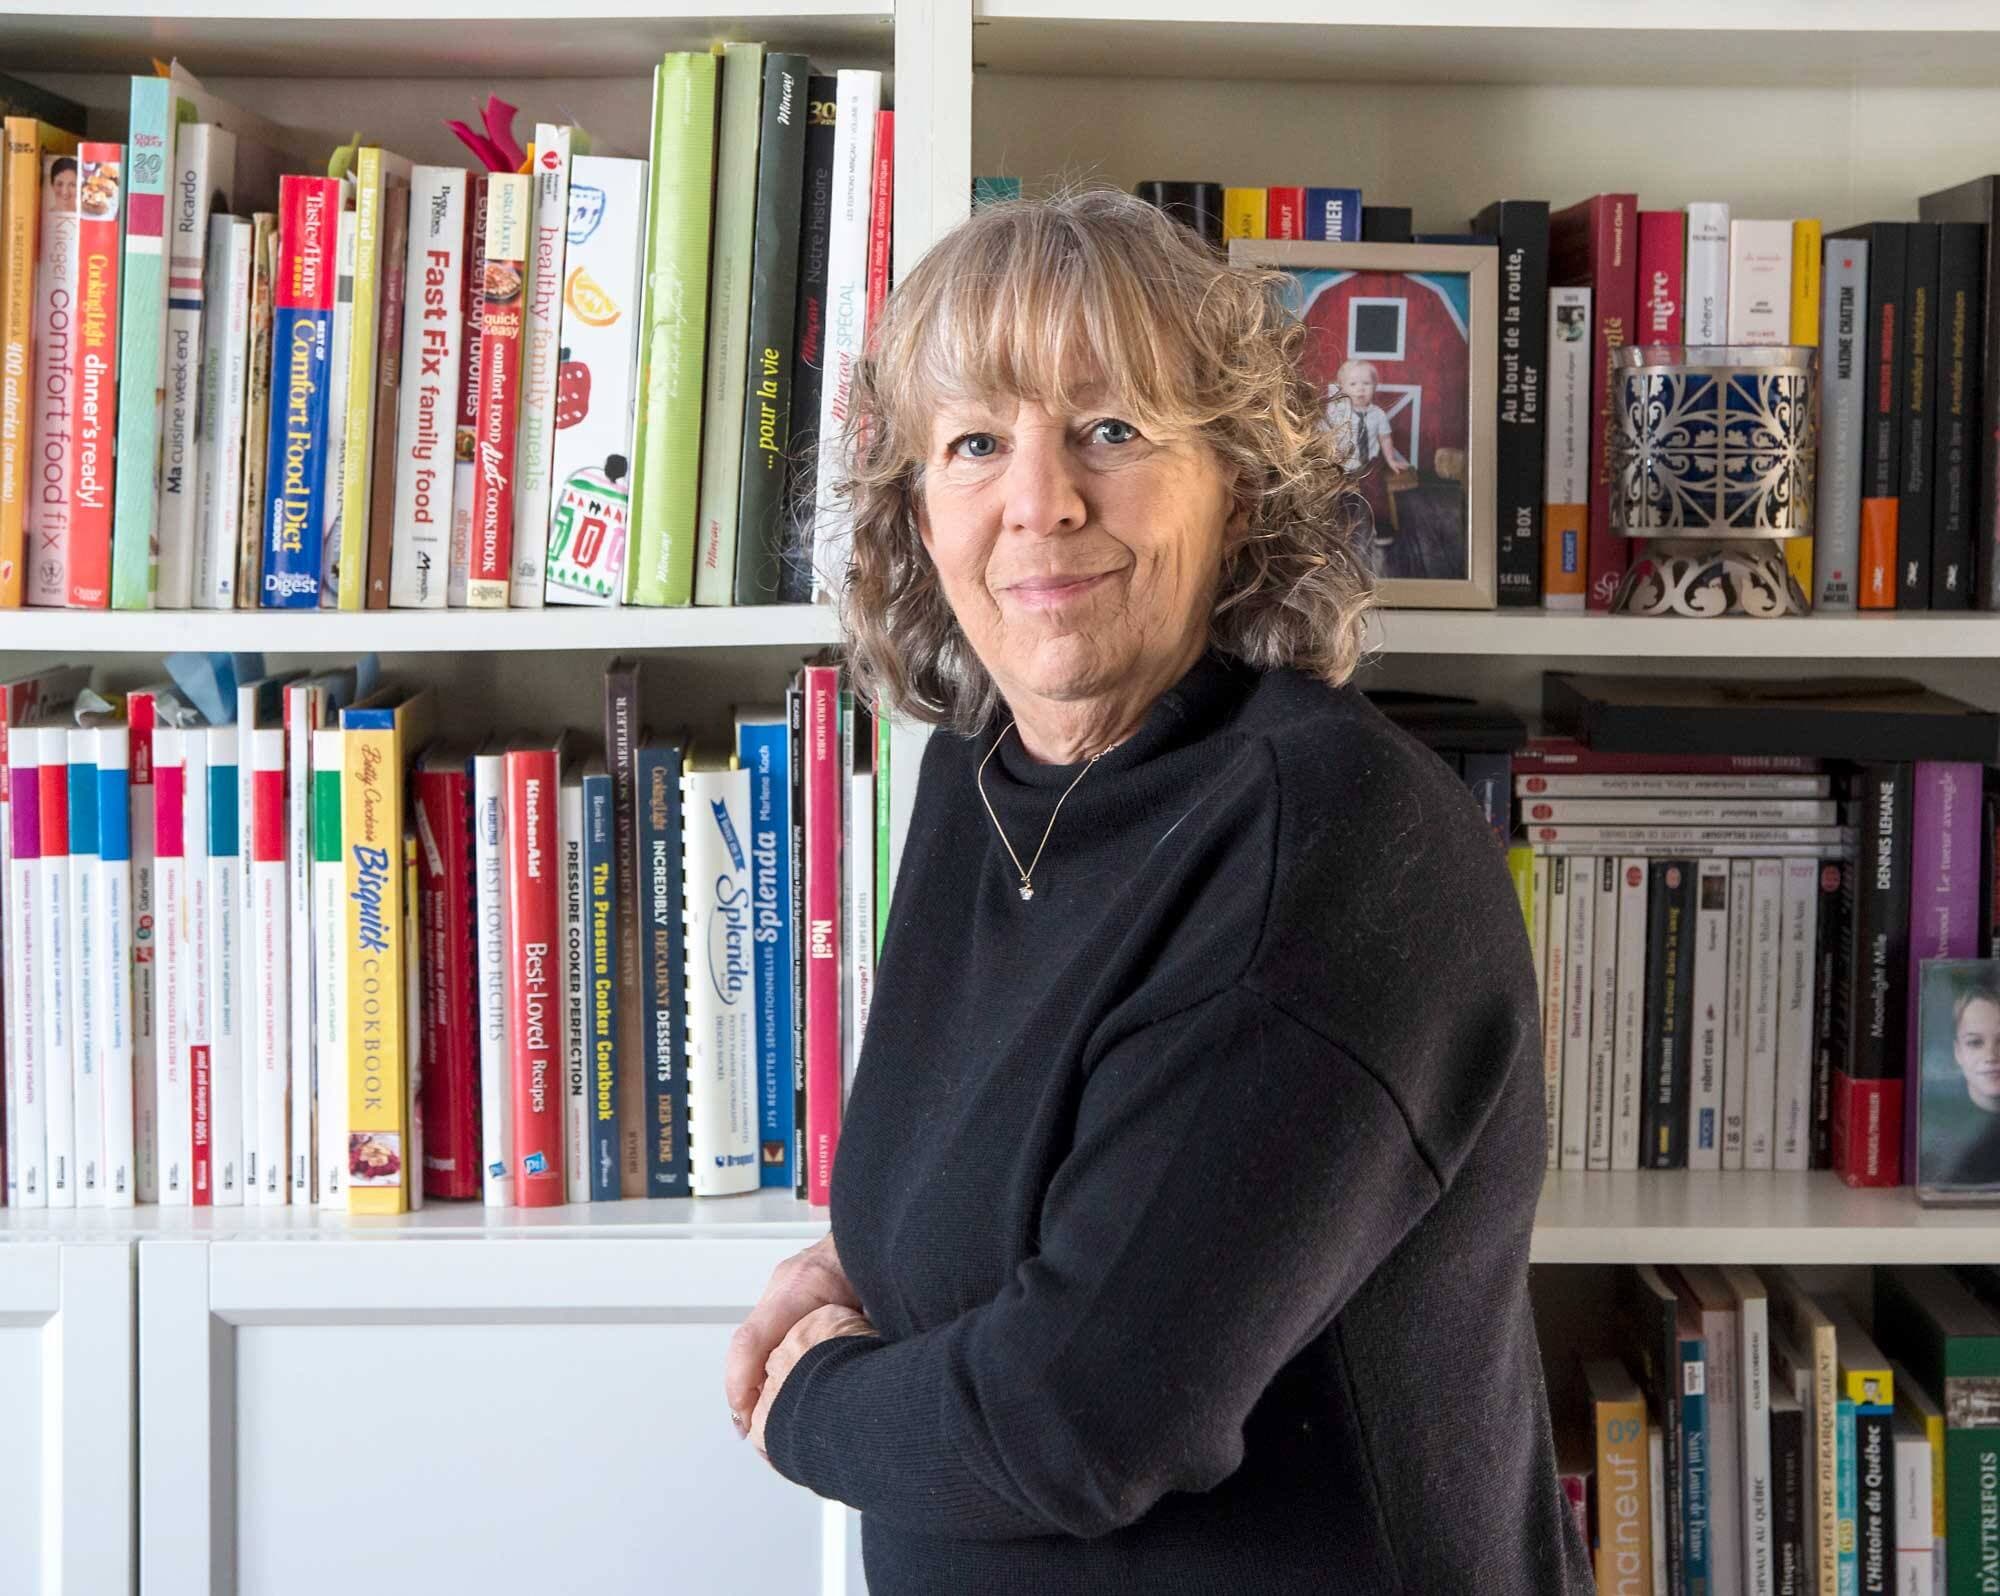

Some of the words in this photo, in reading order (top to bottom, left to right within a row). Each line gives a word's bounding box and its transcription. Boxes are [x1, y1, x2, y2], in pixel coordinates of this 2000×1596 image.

[178, 169, 198, 233] Ricardo
[304, 191, 324, 236] Taste
[359, 187, 374, 240] bread
[437, 184, 452, 218] Better
[808, 167, 829, 232] histoire
[1613, 202, 1624, 229] Cliche
[49, 214, 77, 282] Krieger
[301, 248, 321, 298] Home
[359, 245, 373, 281] book
[529, 226, 561, 322] healthy
[805, 233, 825, 285] Notre
[1506, 247, 1525, 301] route,
[1612, 229, 1622, 267] Normand
[292, 255, 303, 297] BOOKS
[423, 248, 451, 320] Fast
[1646, 271, 1676, 332] mère
[317, 319, 326, 344] BEST
[484, 312, 520, 327] quick
[836, 281, 856, 348] SPÉCIAL
[1503, 306, 1520, 322] la
[1701, 295, 1714, 338] chiens
[1838, 286, 1855, 335] CHATTAM
[5, 341, 24, 375] 400
[45, 288, 74, 421] comfort
[173, 329, 190, 360] end
[315, 346, 325, 361] OF
[421, 328, 449, 377] Fix
[757, 347, 780, 377] vie
[1503, 327, 1520, 349] de
[1837, 338, 1853, 380] MAXIME
[172, 361, 189, 404] week
[288, 319, 316, 427] Comfort
[491, 342, 507, 400] comfort
[524, 327, 558, 411] family
[755, 380, 779, 399] la
[1502, 352, 1520, 394] bout
[1520, 365, 1537, 424] l'enfer
[3, 376, 23, 440] calories
[82, 353, 108, 440] dinner's
[411, 385, 441, 460] family
[490, 403, 504, 443] FOOD
[1501, 400, 1518, 424] Au
[168, 408, 186, 465] cuisine
[524, 415, 546, 492] meals
[757, 402, 780, 452] pour
[42, 430, 71, 505] food
[76, 441, 105, 509] ready!
[167, 466, 183, 494] Ma
[284, 429, 313, 495] Food
[480, 442, 508, 491] diet
[413, 468, 436, 524] food
[1516, 506, 1532, 538] BOX
[41, 511, 68, 551] fix
[271, 497, 284, 553] COOKBOOK
[280, 499, 310, 554] Diet
[482, 487, 500, 573] COOKBOOK
[1563, 531, 1577, 573] POCKET
[265, 575, 318, 597] Digest
[615, 696, 629, 768] MEILLEUR
[792, 698, 801, 730] RICARDO
[815, 688, 827, 761] BAIRD/HOBBS
[355, 743, 382, 788] Betty
[757, 744, 770, 774] Koch
[361, 788, 382, 843] Crocker's
[1878, 780, 1895, 836] LEHANE
[1938, 771, 1957, 828] aveugle
[525, 778, 541, 878] KitchenAid
[1939, 831, 1953, 871] tueur
[485, 856, 501, 895] BEST
[567, 840, 580, 923] PRESSURE
[592, 862, 610, 897] The
[652, 839, 669, 926] INCREDIBLY
[752, 830, 784, 944] Splenda
[1876, 837, 1893, 890] DENNIS
[1936, 873, 1952, 893] Le
[350, 844, 390, 954] Bisquick
[487, 904, 504, 964] LOVED
[568, 927, 581, 994] COOKER
[592, 900, 610, 974] Pressure
[715, 874, 750, 993] Splenda
[811, 919, 834, 960] Noël
[1872, 933, 1888, 966] Mile
[654, 929, 670, 1006] DECADENT
[858, 964, 869, 1006] mange?
[487, 970, 505, 1041] RECIPES
[525, 942, 550, 1051] Best-Loved
[594, 978, 612, 1036] Cooker
[762, 945, 776, 1049] SENSATIONNELLES
[1870, 967, 1889, 1038] Moonlight
[361, 958, 383, 1112] COOKBOOK
[569, 996, 583, 1097] PERFECTION
[655, 1009, 672, 1082] DESSERTS
[530, 1058, 549, 1113] Recipes
[596, 1039, 615, 1122] Cookbook
[764, 1052, 777, 1107] RECETTES
[1701, 1056, 1713, 1093] robert
[195, 1086, 208, 1122] calories
[657, 1094, 671, 1125] DEB
[194, 1122, 208, 1147] 1500
[658, 1125, 673, 1163] WISE
[818, 1133, 828, 1187] MADISON
[1866, 1091, 1881, 1176] RIVAGES/THRILLER
[1687, 1431, 1704, 1463] Saint
[1863, 1423, 1883, 1488] Québec
[1688, 1467, 1704, 1502] Louis
[1688, 1502, 1705, 1519] de
[1750, 1475, 1766, 1522] QUÉBEC
[1864, 1490, 1882, 1513] du
[1688, 1519, 1706, 1561] France
[1752, 1525, 1766, 1543] AU
[1974, 1451, 1999, 1594] D'AUTREFOIS
[1780, 1542, 1797, 1596] Disques
[1864, 1515, 1883, 1592] L'Histoire
